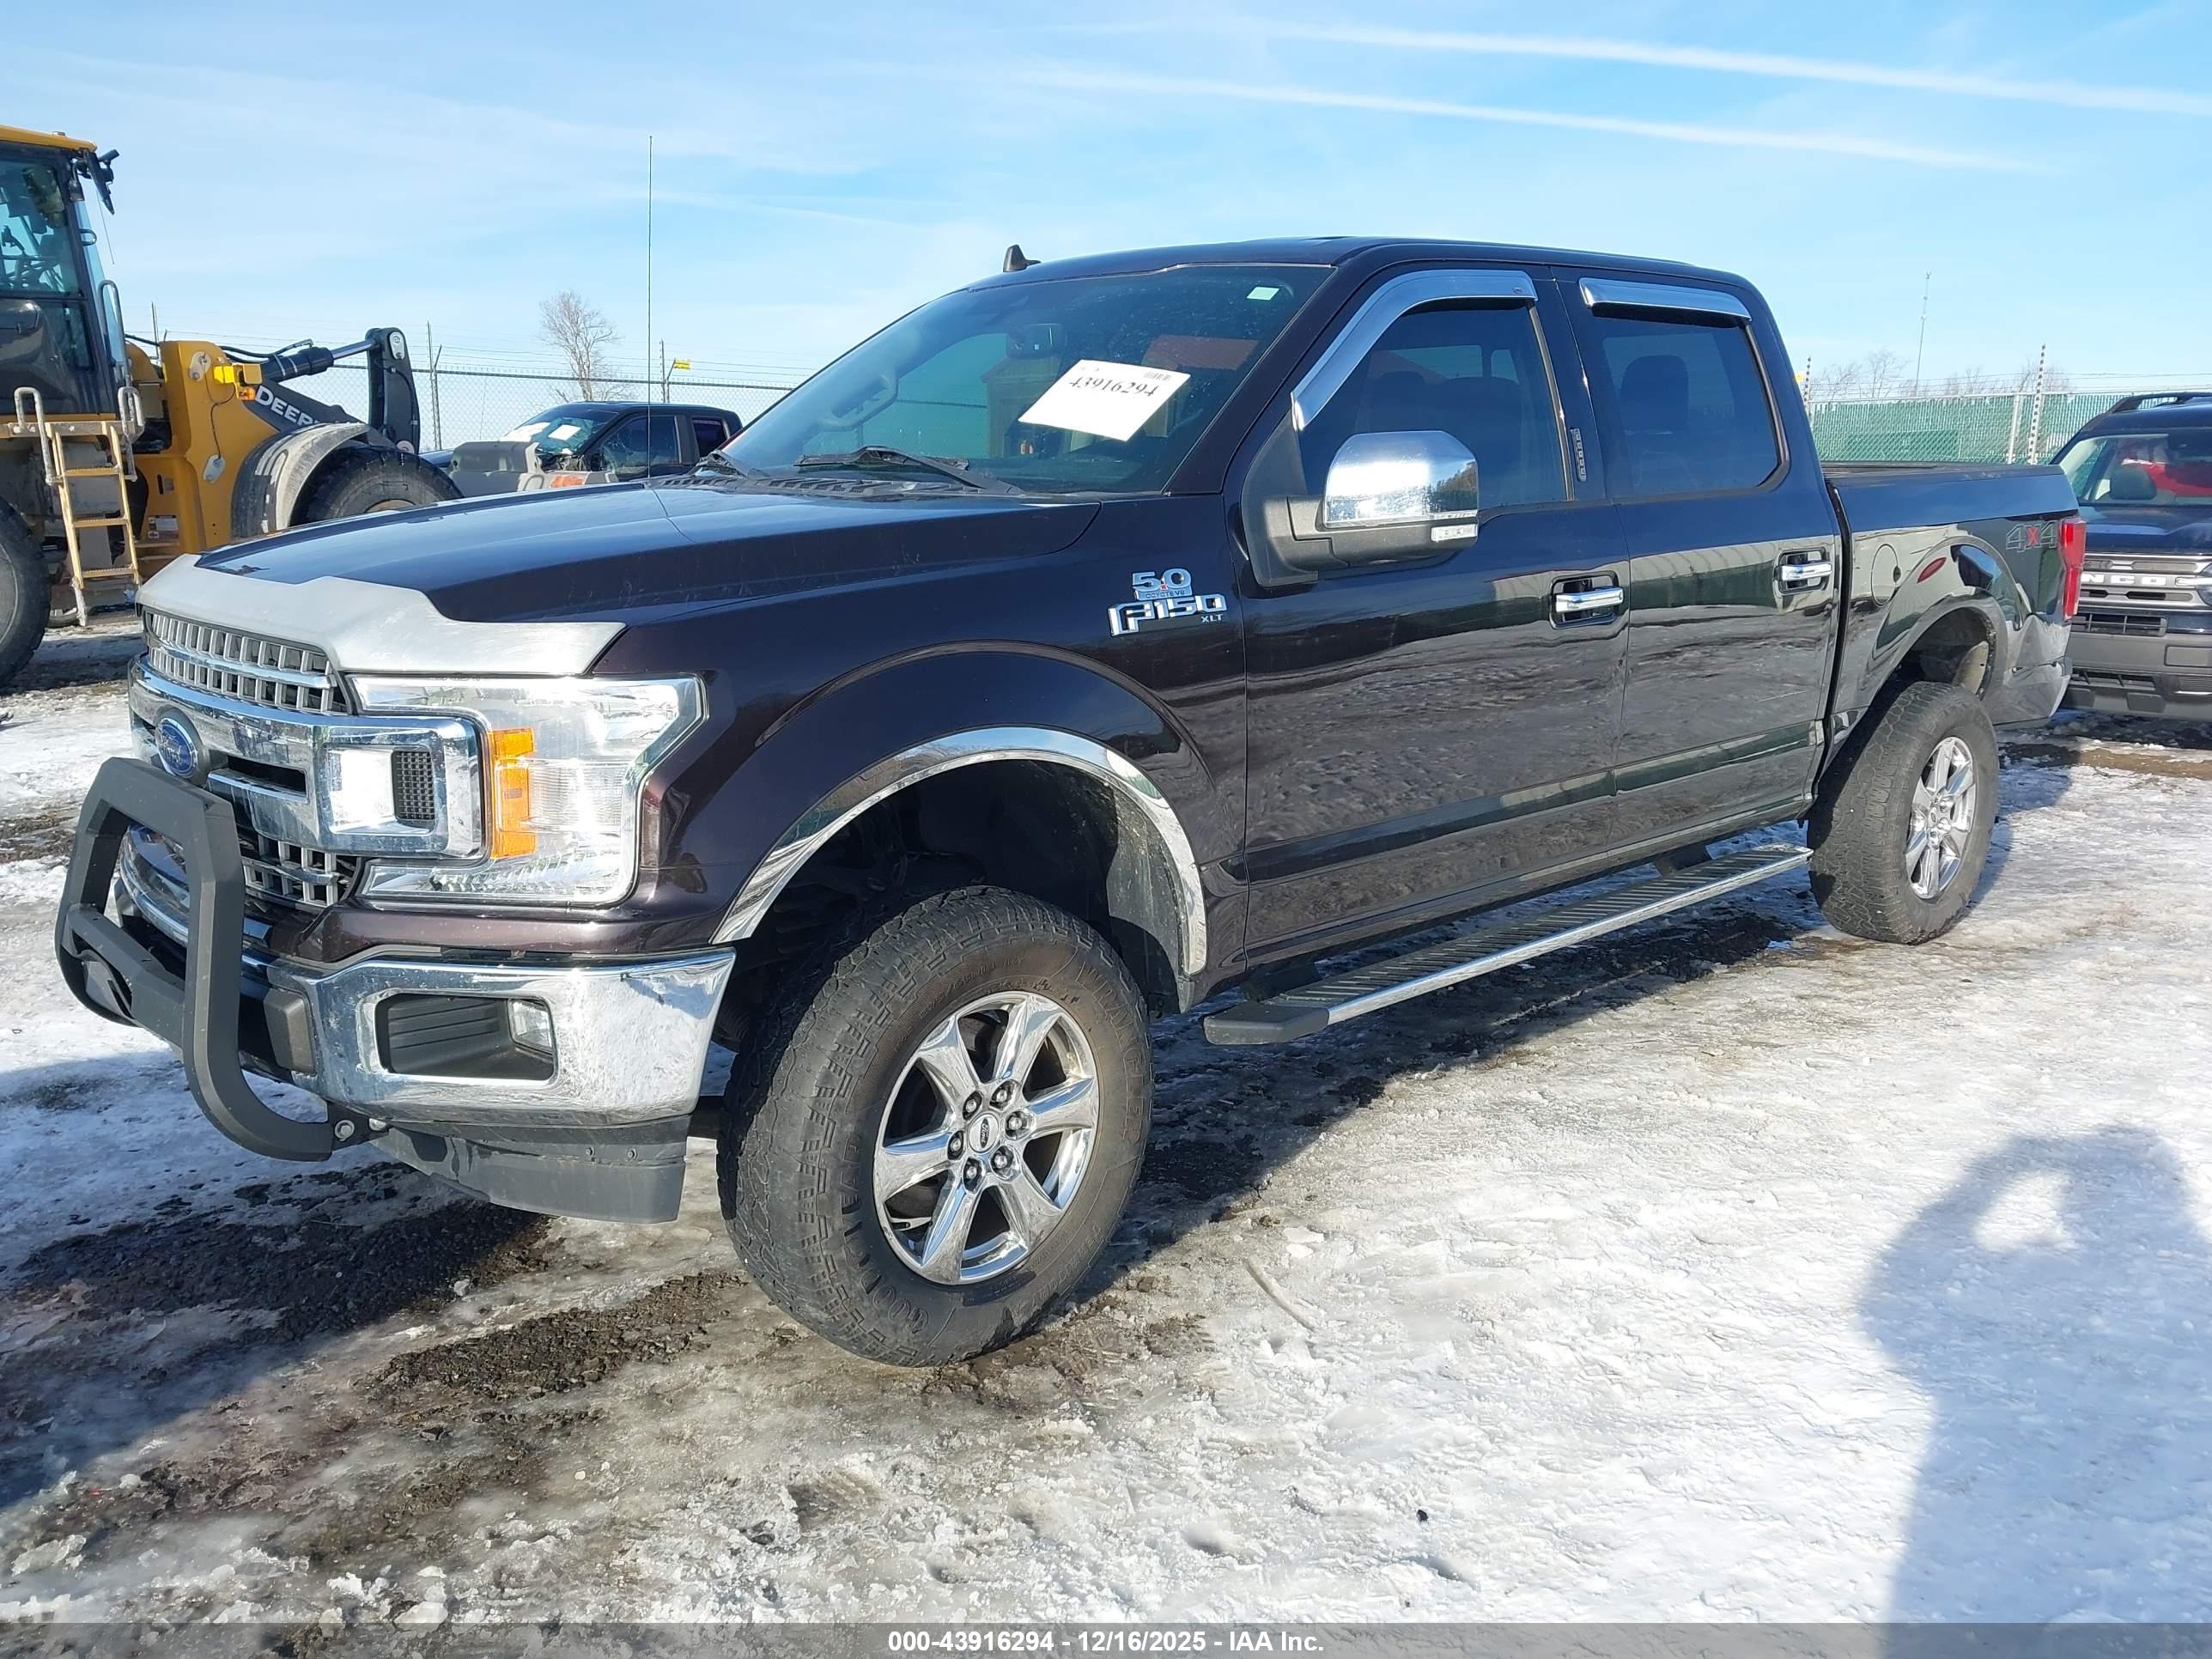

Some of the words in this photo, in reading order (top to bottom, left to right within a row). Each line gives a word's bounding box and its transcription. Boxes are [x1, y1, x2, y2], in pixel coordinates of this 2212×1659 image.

[1069, 376, 1159, 397] 43916294
[255, 386, 321, 427] DEER
[1132, 568, 1192, 592] 5.0
[1200, 614, 1224, 623] XLT
